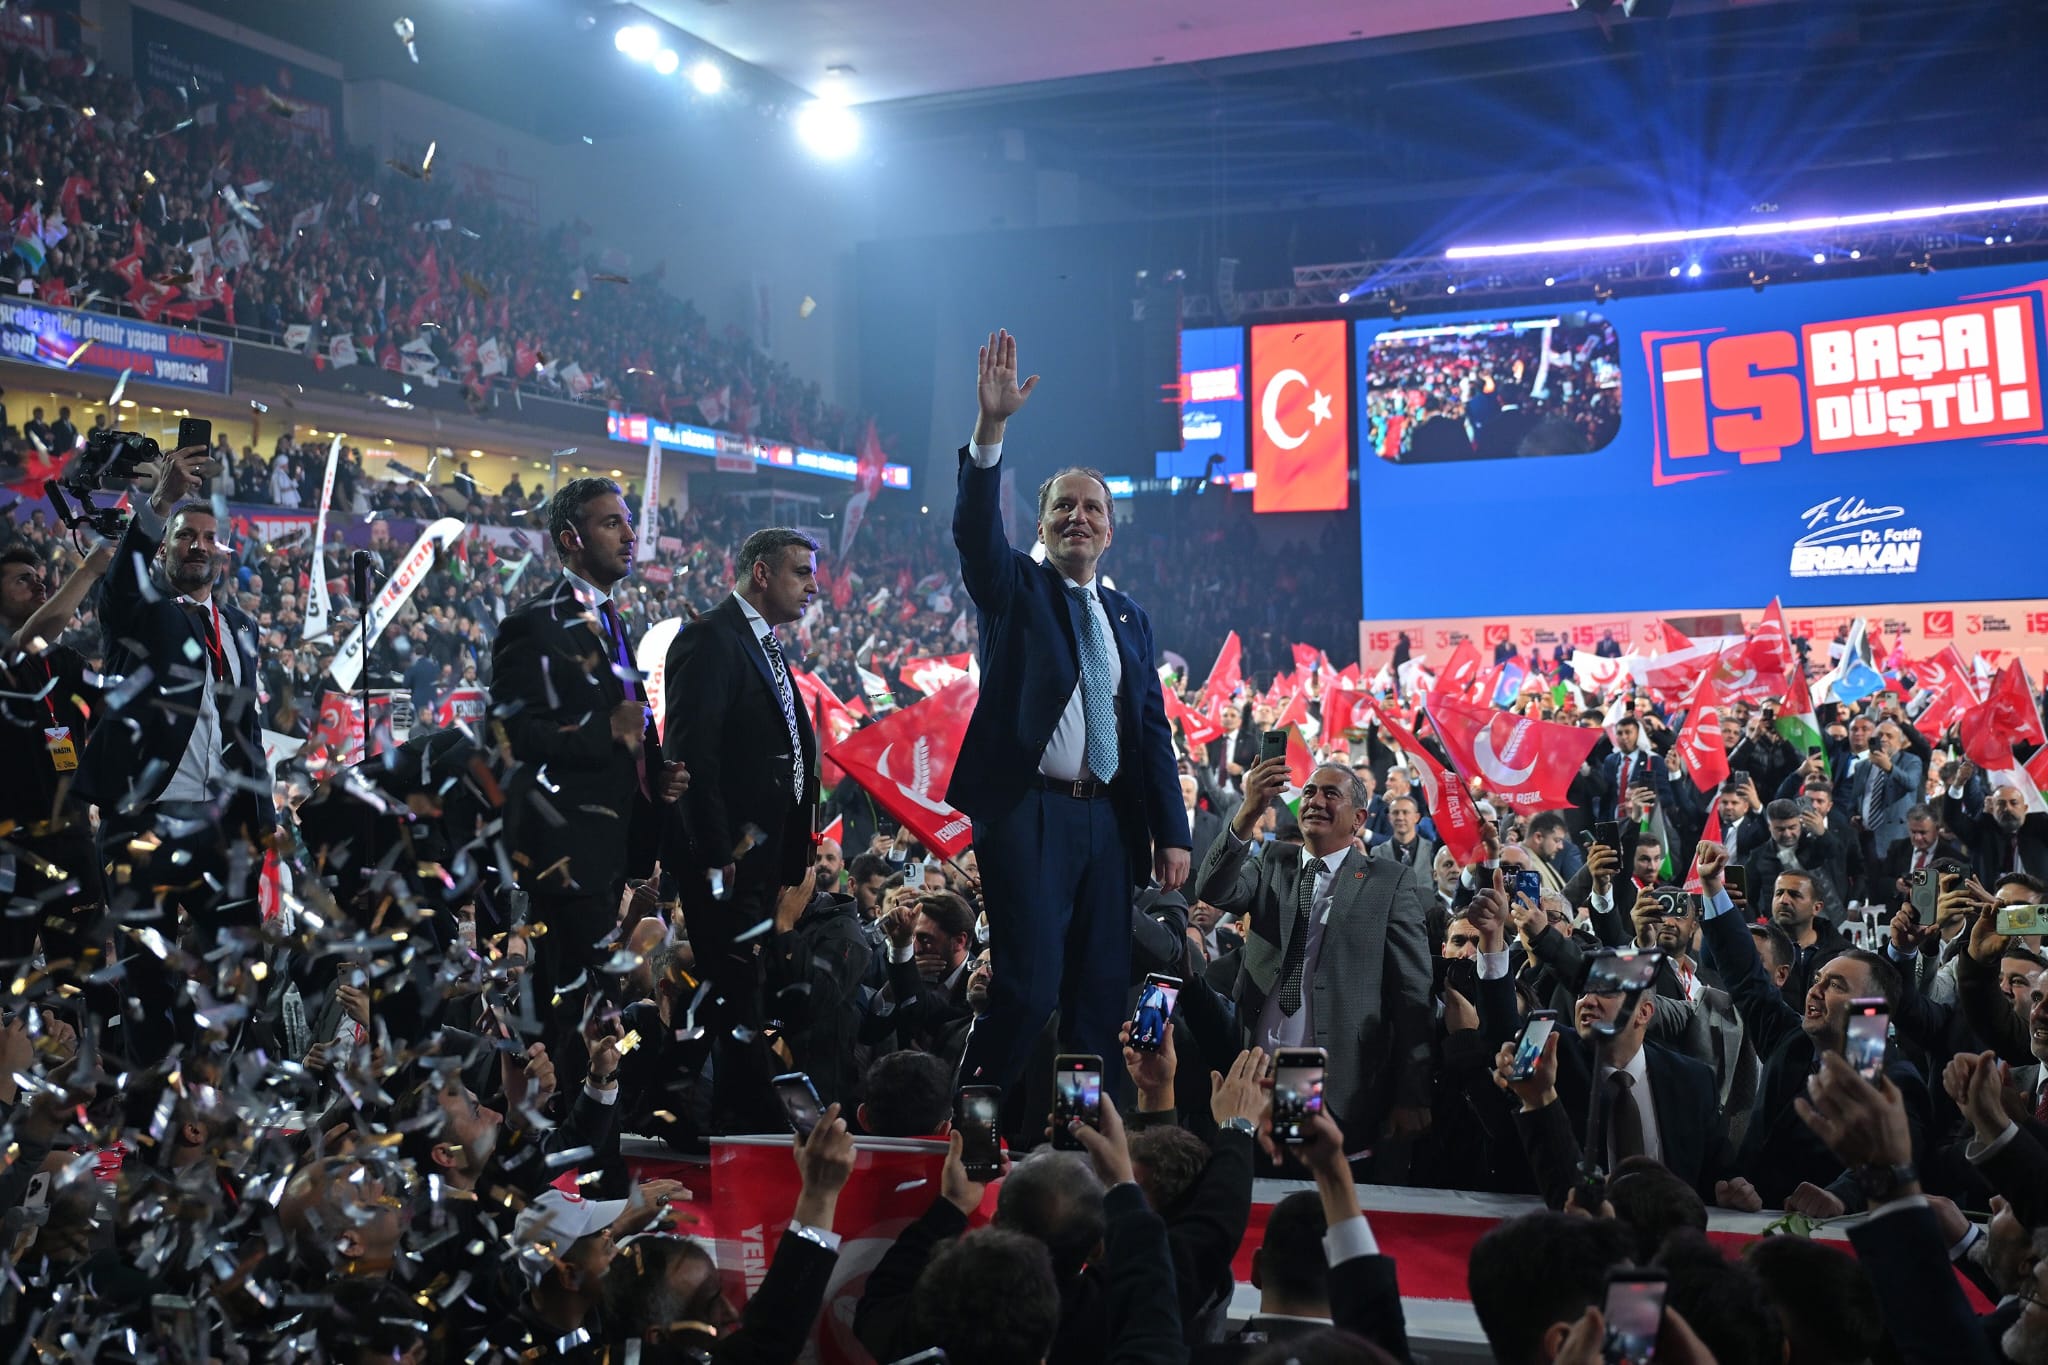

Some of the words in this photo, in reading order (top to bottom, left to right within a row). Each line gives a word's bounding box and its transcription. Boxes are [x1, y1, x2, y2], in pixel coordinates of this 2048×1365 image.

[83, 317, 125, 345] demir
[126, 328, 167, 353] yapan
[1810, 313, 1989, 386] BAŞA
[2, 330, 37, 356] seni
[155, 359, 209, 385] yapacak
[1860, 529, 1881, 543] Dr.
[1883, 528, 1922, 542] Fatih
[1790, 542, 1920, 571] ERBAKAN
